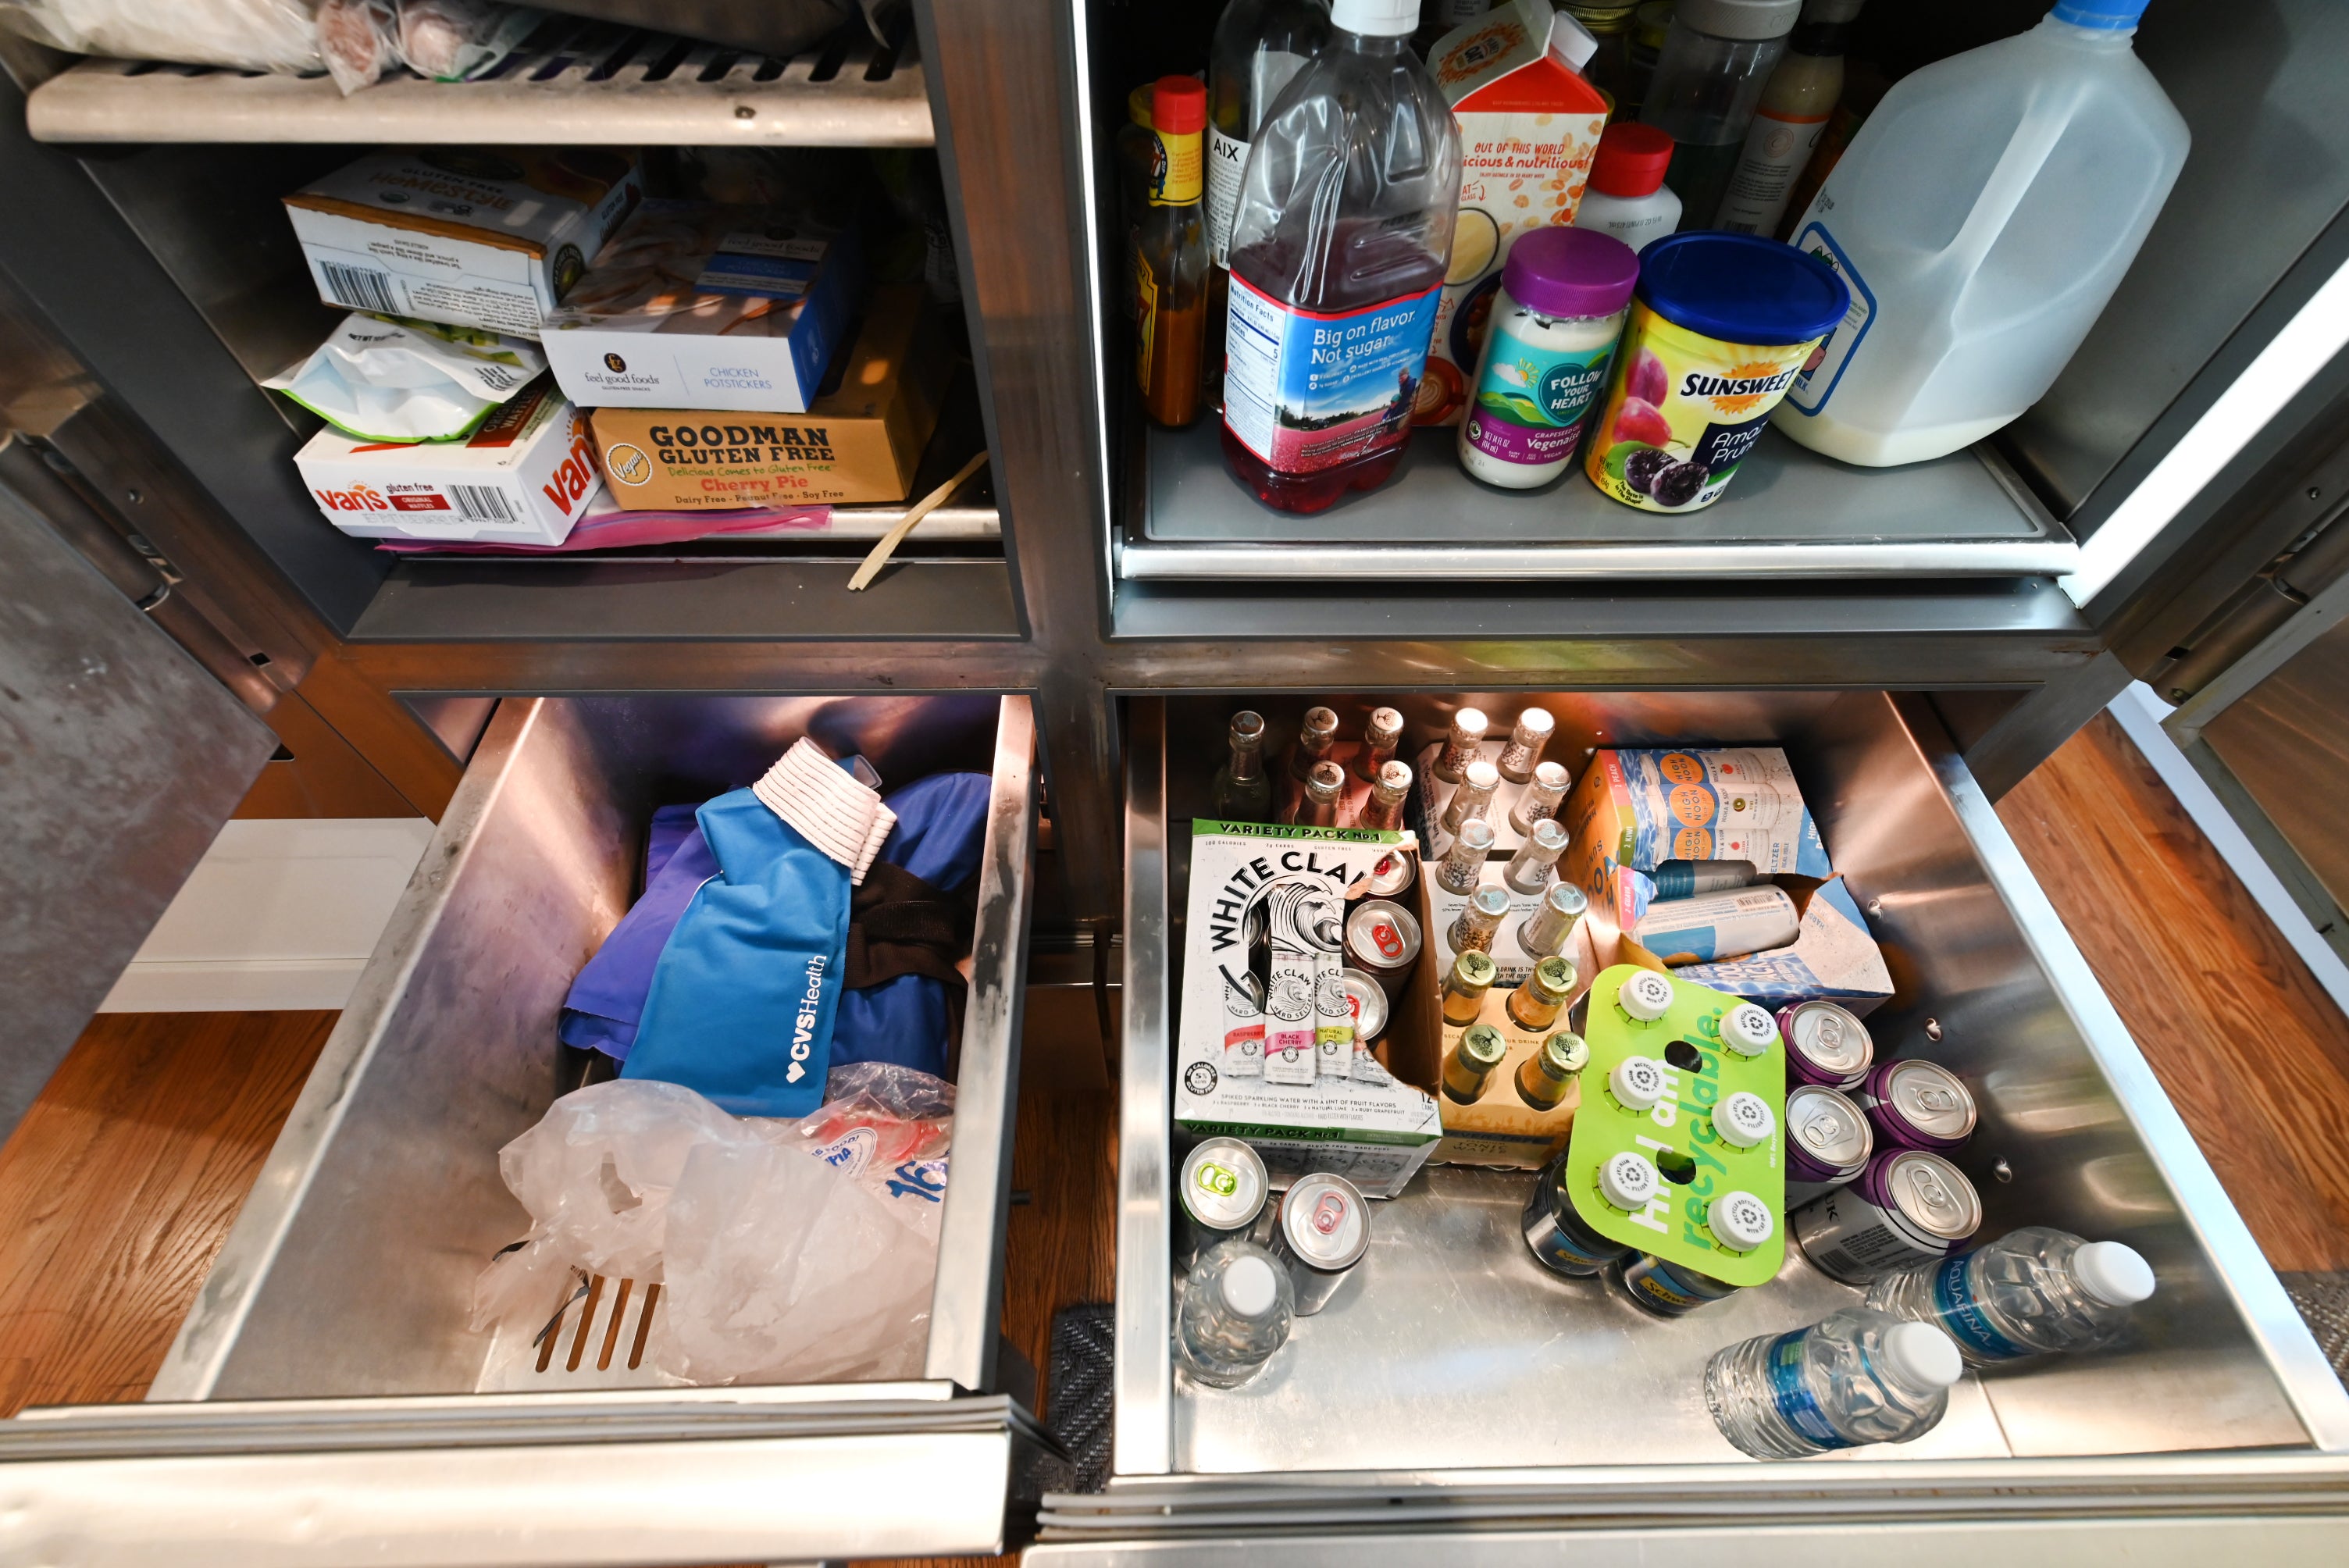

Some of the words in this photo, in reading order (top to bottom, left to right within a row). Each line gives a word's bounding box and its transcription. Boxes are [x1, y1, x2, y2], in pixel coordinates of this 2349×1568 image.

[1214, 138, 1239, 162] AIX
[1512, 143, 1531, 154] THIS
[1535, 144, 1565, 155] WORLD
[1463, 155, 1502, 167] icious
[1505, 156, 1513, 168] &
[1517, 155, 1590, 169] nutritious!
[401, 168, 464, 184] GLUTEN
[469, 181, 504, 194] FREE
[1231, 285, 1254, 310] Nutrition
[1255, 305, 1274, 323] Facts
[1230, 318, 1246, 337] Calories
[1314, 329, 1343, 347] Big
[1346, 325, 1366, 340] on
[1370, 310, 1416, 334] flavor.
[1274, 348, 1279, 359] 5
[1311, 348, 1341, 365] Not
[1346, 335, 1391, 359] sugar.
[585, 372, 603, 383] feel
[605, 373, 629, 385] good
[631, 373, 660, 384] foods
[709, 367, 759, 378] CHICKEN
[1551, 369, 1603, 390] FOLLOW
[1680, 365, 1799, 397] SUNSWEET
[704, 378, 772, 390] POTSTICKERS
[1564, 384, 1589, 397] YOUR
[1550, 391, 1592, 409] HEART
[650, 426, 830, 447] GOODMAN
[1527, 430, 1581, 451] Vegenaise
[1535, 427, 1570, 439] GRAPESEED
[614, 451, 643, 479] Vegan
[658, 447, 761, 465] GLUTEN
[771, 446, 836, 462] FREE
[543, 437, 599, 516] van
[668, 466, 714, 477] Delicious
[718, 466, 750, 476] Comes
[768, 464, 804, 474] Gluten
[386, 483, 414, 494] gluten
[415, 483, 434, 492] free
[700, 476, 770, 492] Cherry
[778, 475, 808, 489] Pie
[1626, 486, 1638, 497] Taste
[675, 495, 702, 504] Dairy
[802, 491, 820, 500] Soy
[1609, 764, 1622, 783] PEACH
[1670, 758, 1683, 780] HIGH
[1678, 757, 1692, 782] NOON
[1681, 790, 1692, 818] HIGH
[1691, 789, 1702, 821] NOON
[1220, 823, 1296, 838] VARIETY
[1302, 828, 1349, 840] PACK
[1353, 831, 1381, 841] No.1
[1624, 825, 1634, 843] KIWI
[1684, 832, 1693, 858] HIGH
[1770, 843, 1780, 873] ELTZER
[1210, 856, 1276, 953] WHITE
[1268, 971, 1283, 1000] WHITE
[1284, 968, 1311, 986] CLAW
[1638, 977, 1647, 993] RECYCLE
[1647, 977, 1663, 986] BOTTLE
[1231, 1005, 1249, 1015] HARD
[1274, 1005, 1292, 1019] HARD
[1296, 992, 1312, 1018] SELTZER
[1193, 1062, 1216, 1078] CALORIES
[1634, 1063, 1654, 1073] RECYCLE
[1186, 1082, 1205, 1094] GLUTEN
[1205, 1082, 1215, 1092] FREE
[1633, 1081, 1642, 1092] CAP
[1651, 1060, 1679, 1127] am
[1187, 1124, 1260, 1135] VARIETY
[1265, 1128, 1310, 1139] PACK
[1679, 1007, 1727, 1249] recyclable.
[1636, 1162, 1649, 1183] RECYCLE
[1631, 1181, 1649, 1192] BOTTLE
[1733, 1202, 1741, 1224] RECYCLE
[1738, 1199, 1756, 1209] BOTTLE
[1948, 1260, 1991, 1345] AQUAFINA
